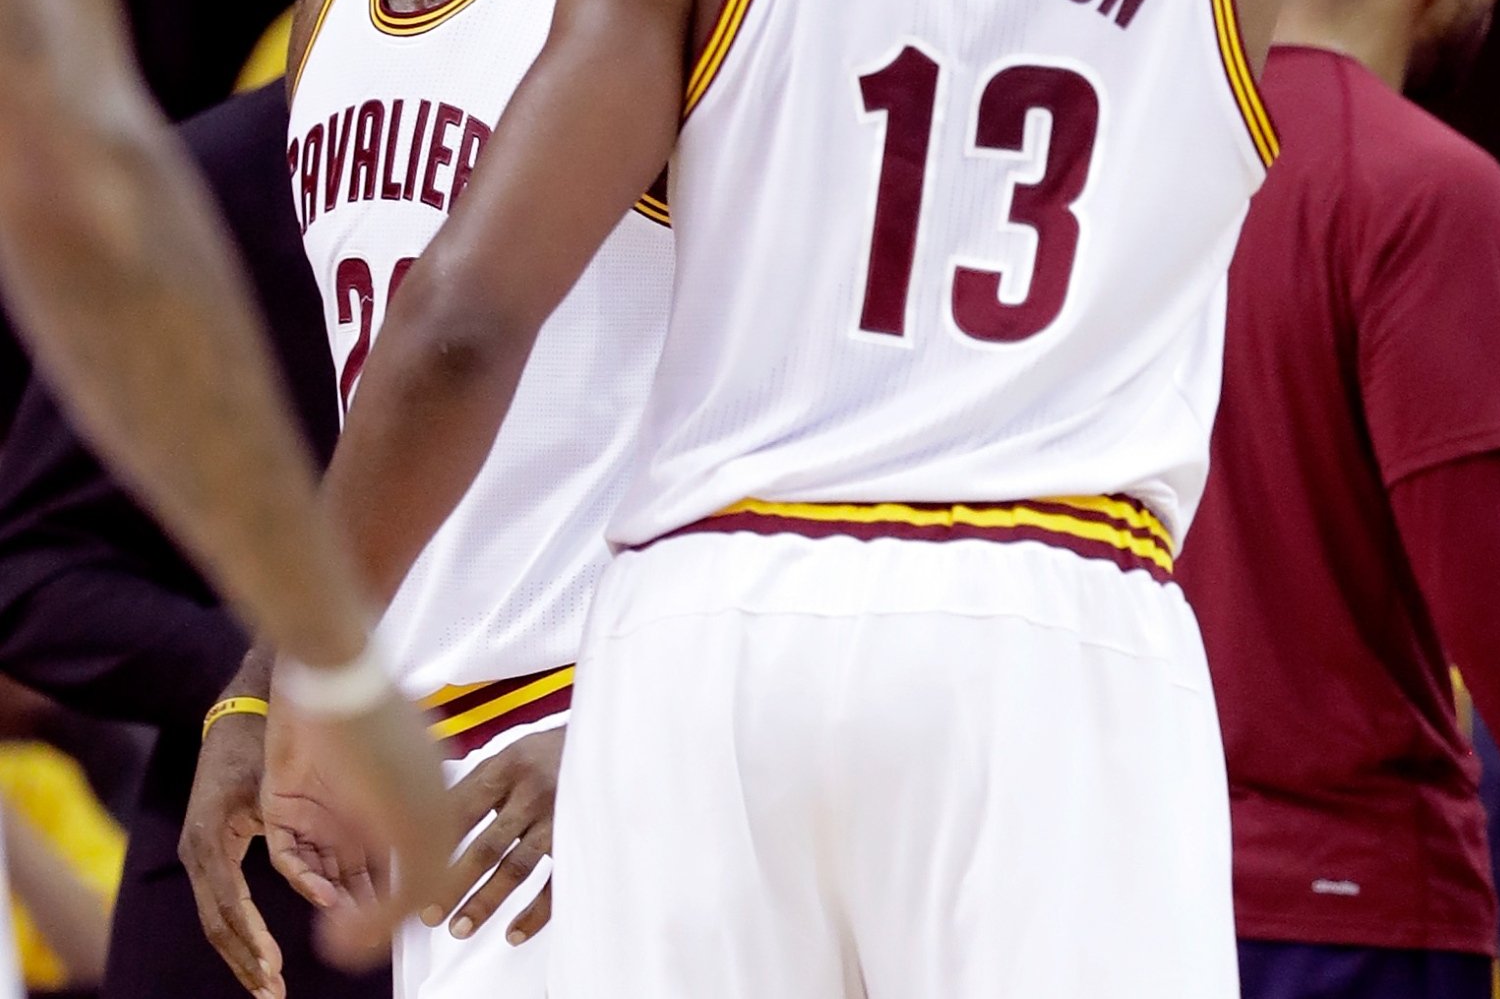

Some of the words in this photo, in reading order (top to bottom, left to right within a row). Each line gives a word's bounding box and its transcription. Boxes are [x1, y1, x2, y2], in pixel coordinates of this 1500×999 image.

[287, 98, 493, 237] AVALIER
[856, 43, 1101, 345] 13
[335, 257, 421, 414] 2
